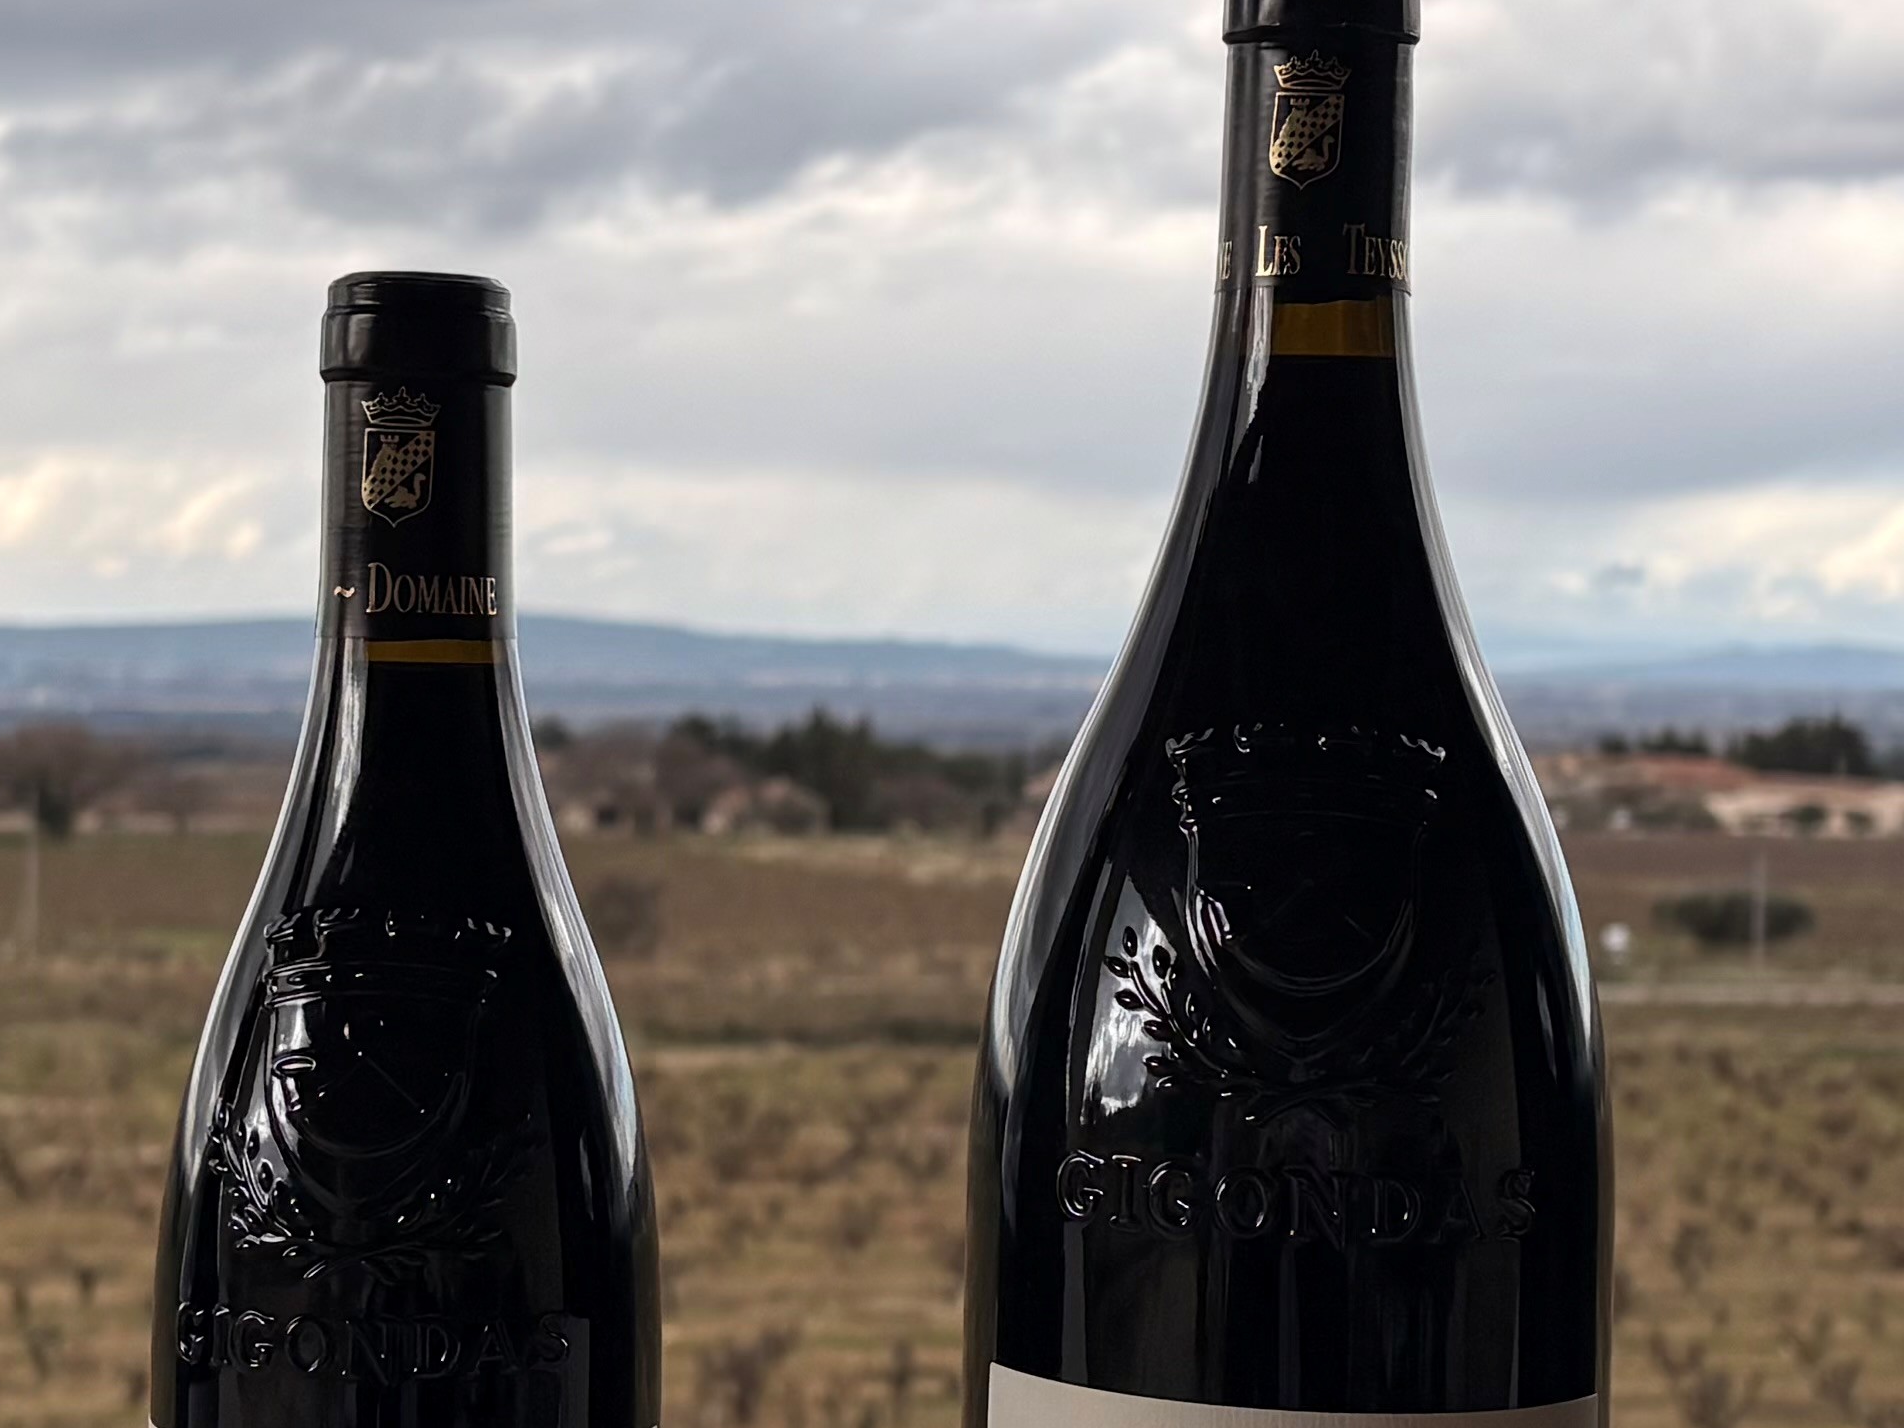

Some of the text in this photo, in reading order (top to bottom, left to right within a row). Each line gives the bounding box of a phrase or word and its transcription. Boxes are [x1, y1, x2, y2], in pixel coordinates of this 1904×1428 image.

[365, 562, 498, 616] DOMAINE
[1056, 1148, 1537, 1253] GIGONDAS
[176, 1301, 570, 1384] GIGONDAS
